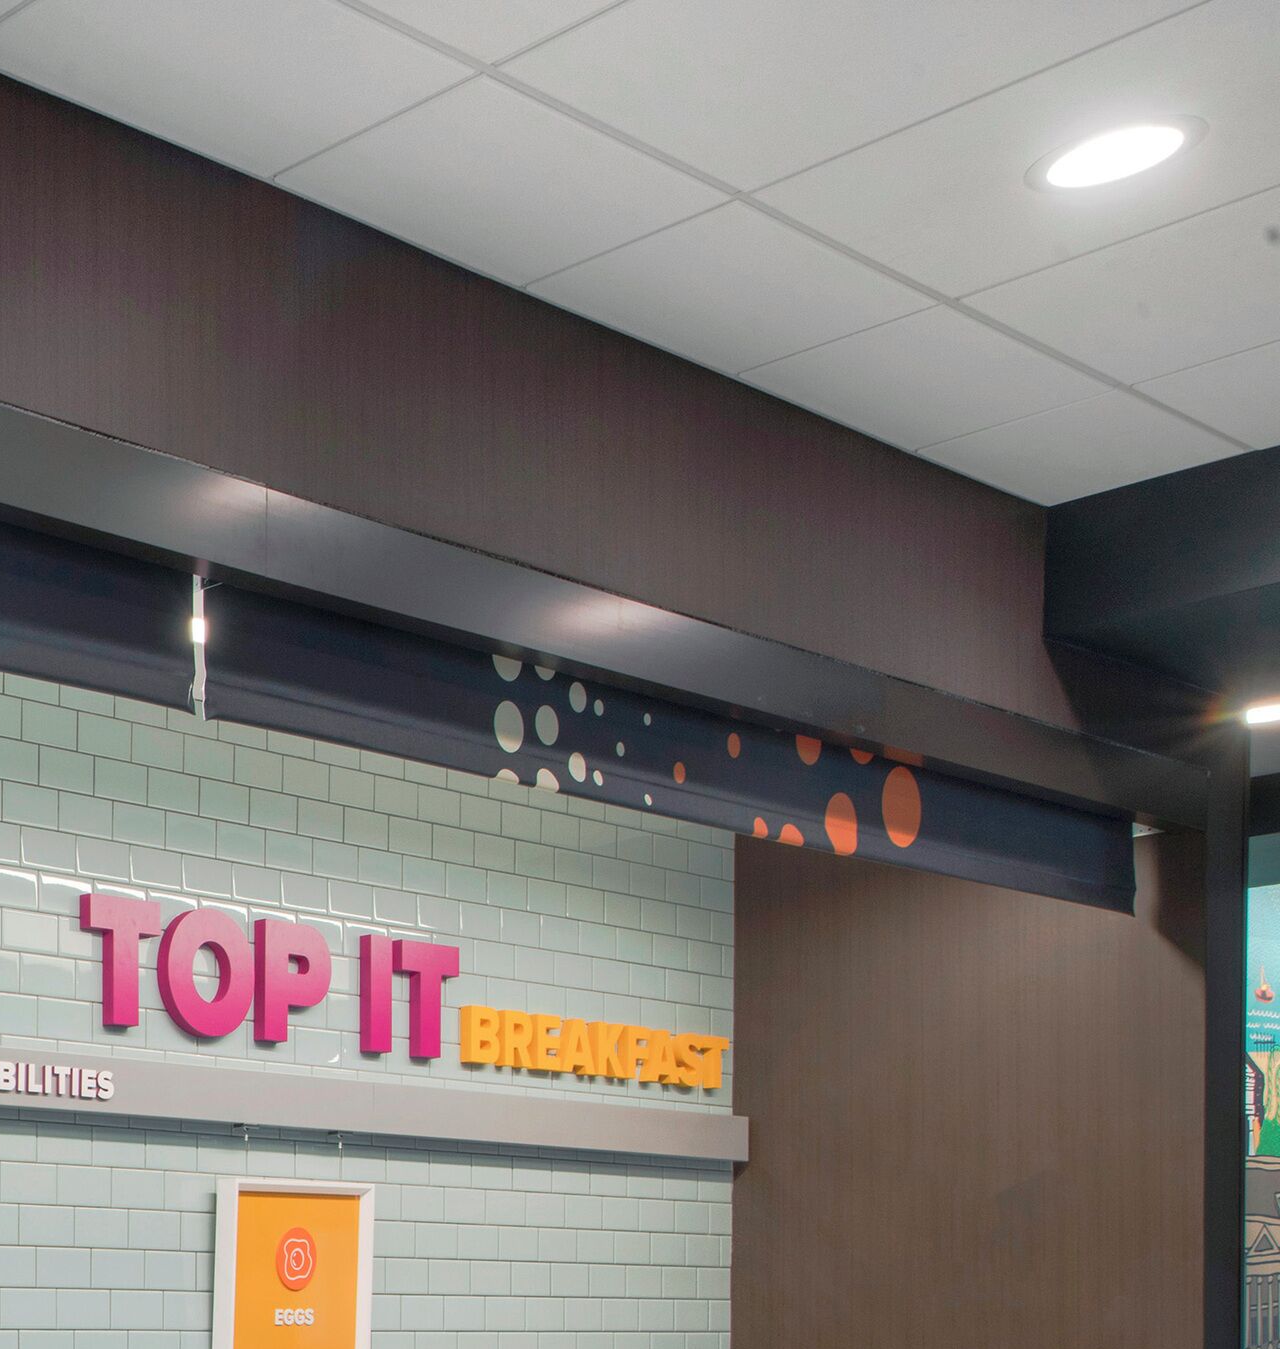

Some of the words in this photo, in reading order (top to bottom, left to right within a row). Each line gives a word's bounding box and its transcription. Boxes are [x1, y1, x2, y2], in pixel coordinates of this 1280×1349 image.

[80, 893, 331, 1045] TOP
[360, 934, 459, 1060] IT
[460, 1004, 730, 1091] BREAKFAST
[274, 1308, 315, 1326] EGGS
